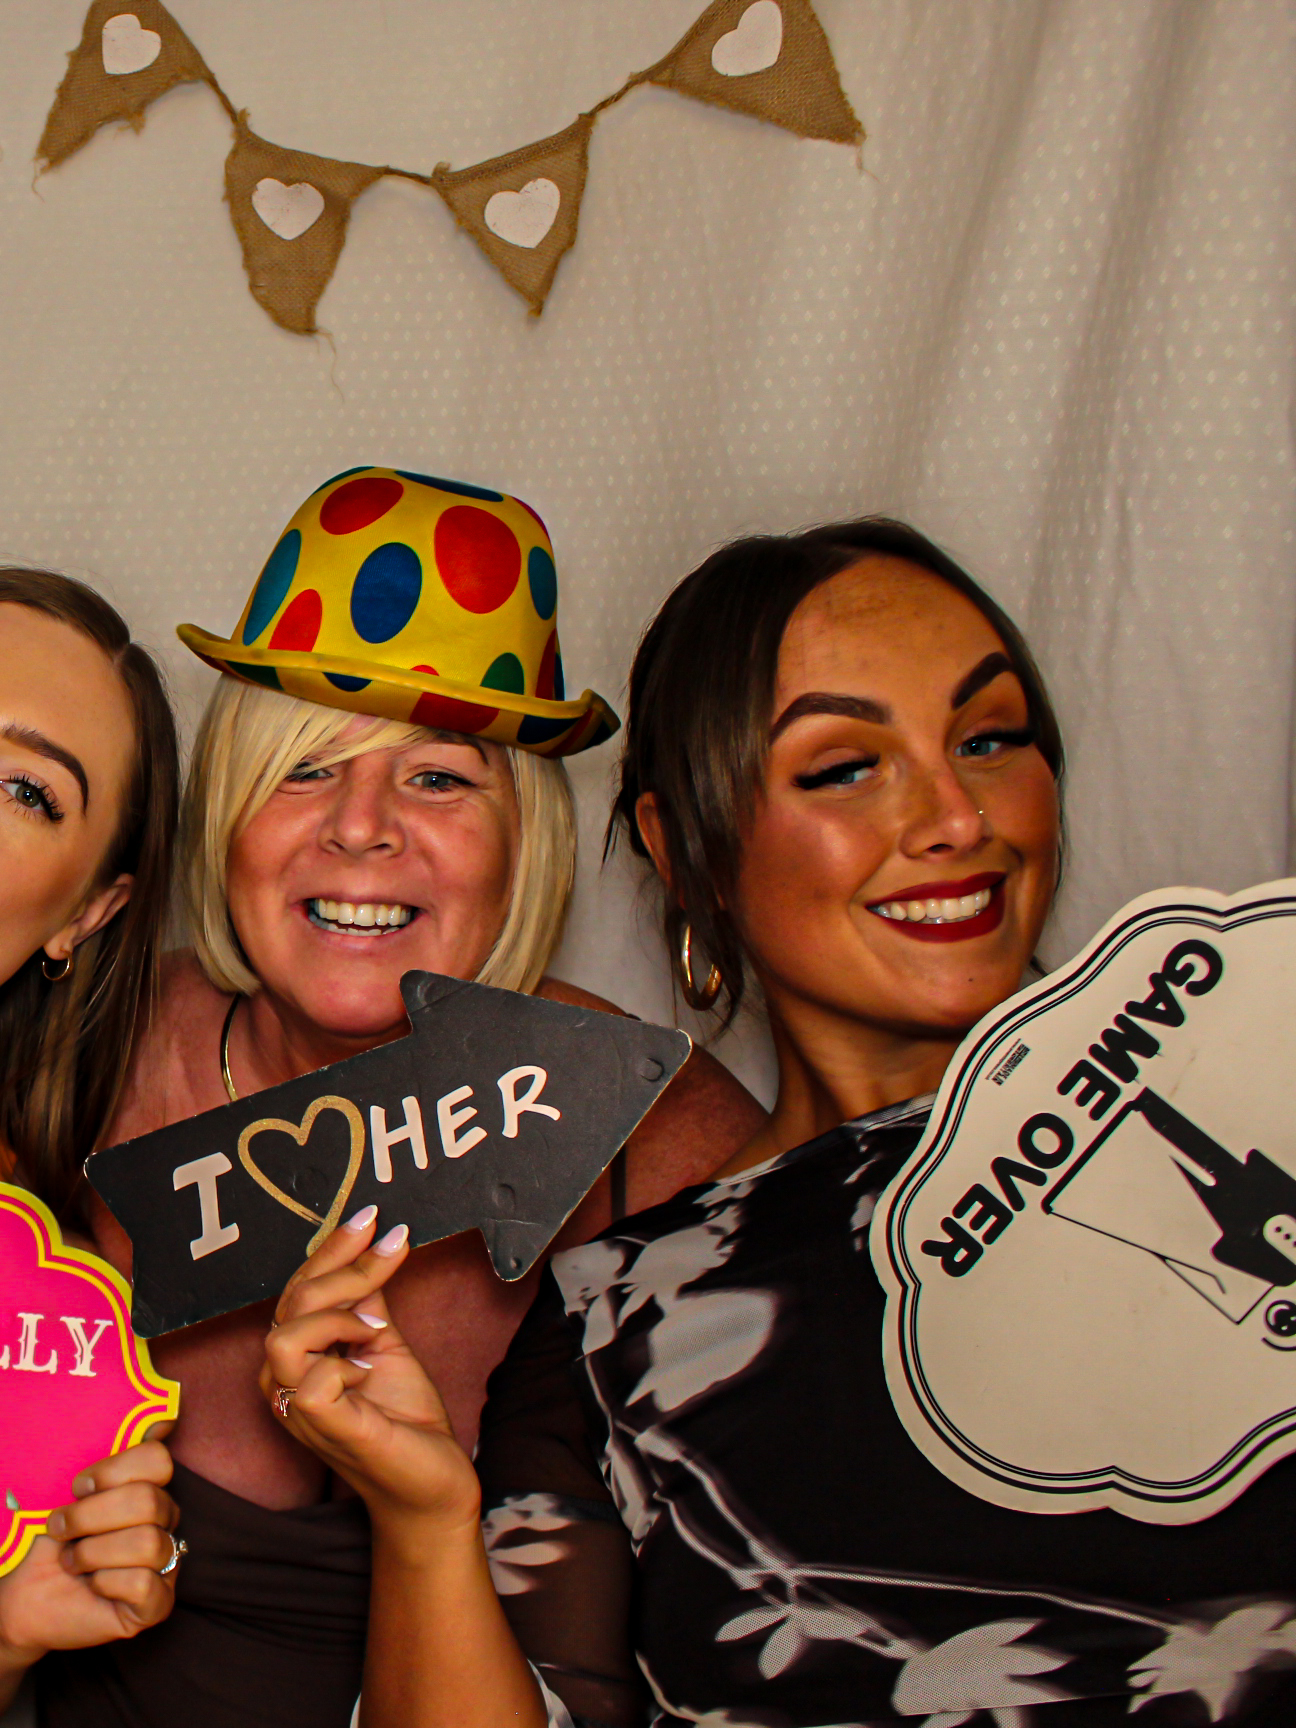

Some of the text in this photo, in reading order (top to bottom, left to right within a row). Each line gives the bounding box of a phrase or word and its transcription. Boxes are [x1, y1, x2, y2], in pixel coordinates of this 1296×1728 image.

[172, 1064, 561, 1261] I HER
[920, 938, 1224, 1278] GAME OVER
